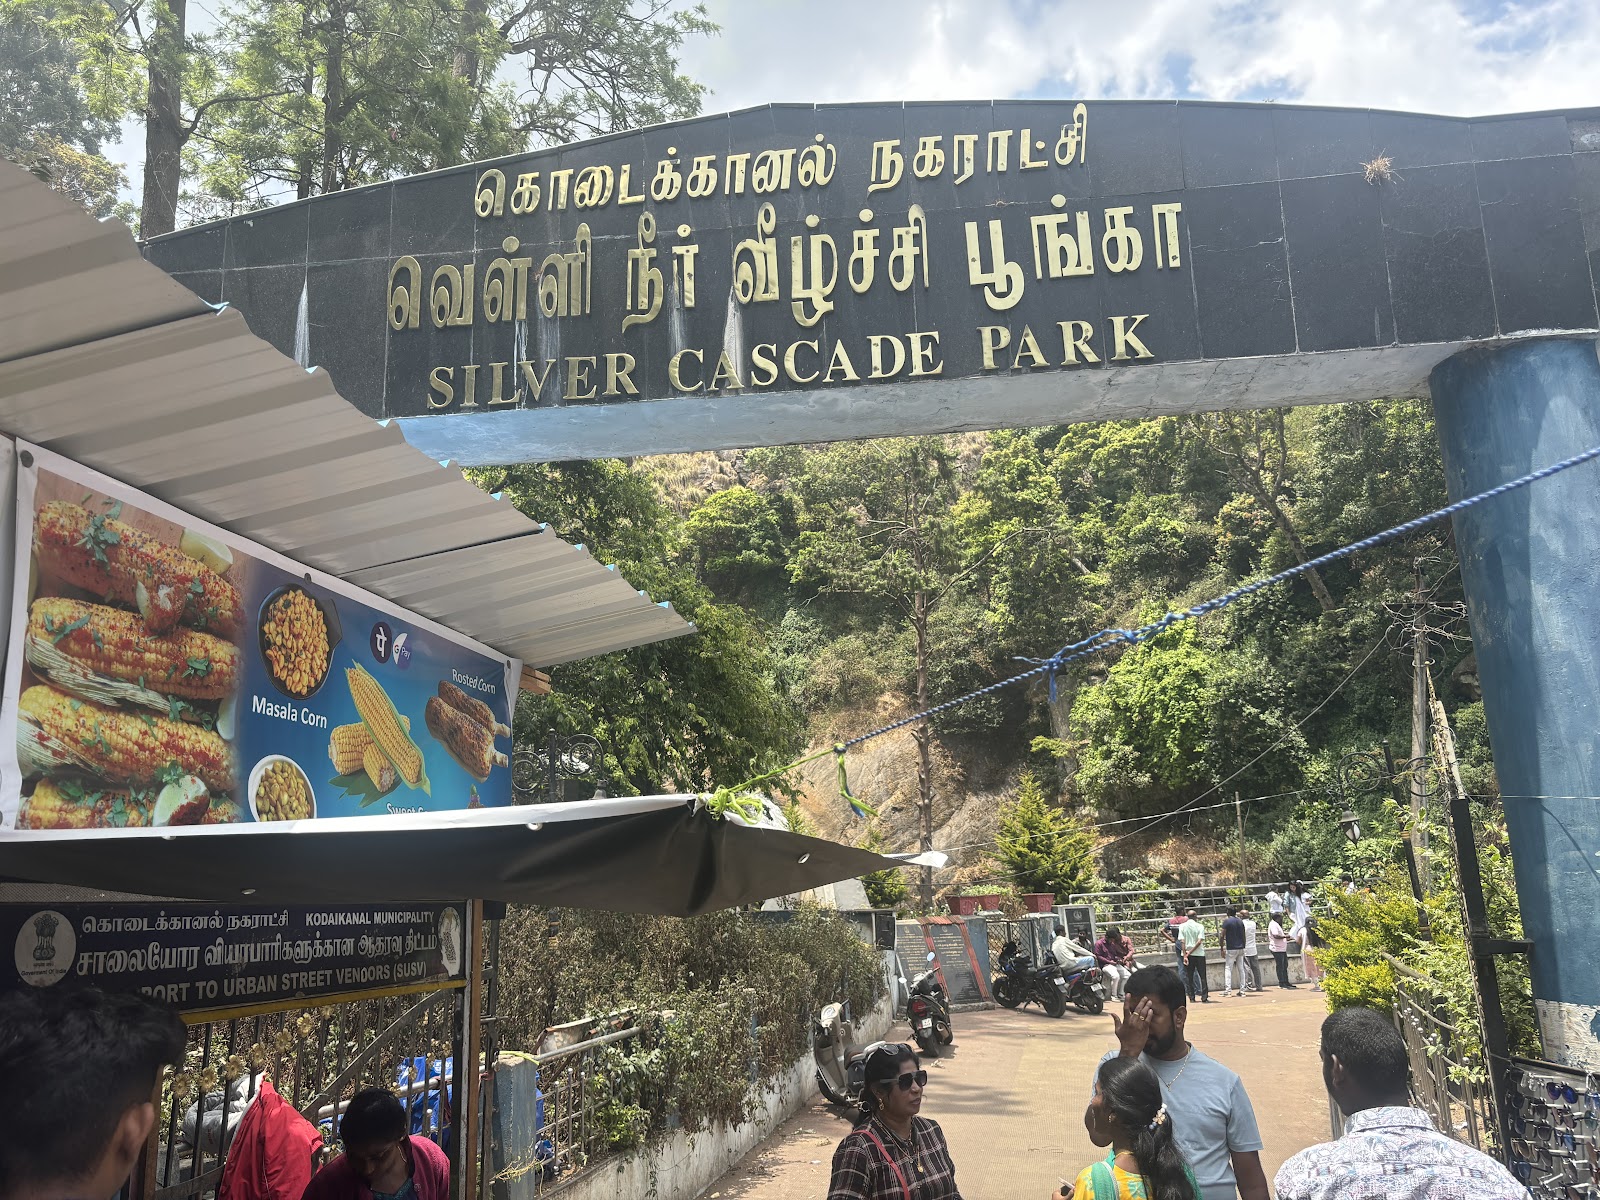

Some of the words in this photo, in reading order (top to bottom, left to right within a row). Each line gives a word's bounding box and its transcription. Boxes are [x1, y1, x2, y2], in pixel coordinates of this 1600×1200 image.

[474, 133, 837, 218] கொடைக்கானல்
[867, 102, 1088, 199] நகராட்சி
[387, 222, 592, 331] வெள்ளி
[621, 210, 699, 334] நீர்
[732, 202, 929, 328] வீழ்ச்சி
[964, 193, 1182, 311] பூங்கா
[426, 352, 640, 410] SILVER
[668, 330, 945, 393] CASCADE
[975, 313, 1155, 370] PARK
[452, 668, 477, 689] Rosted
[477, 679, 496, 695] Corn
[252, 695, 298, 723] Masala
[300, 707, 328, 729] Corn
[82, 910, 224, 933] கொடைக்கானல்
[226, 909, 289, 933] நகராட்சி
[305, 911, 371, 926] KODAIKANAL
[373, 911, 435, 925] MUNICIPALITY
[76, 941, 201, 976] சாலையோர
[357, 934, 403, 959] ஆதரவு
[404, 927, 438, 956] திட்டம்
[195, 980, 218, 1000] TO
[223, 974, 277, 997] URBAN
[281, 969, 333, 991] STREET
[336, 964, 391, 985] VENDORS
[393, 961, 427, 982] (SUSV)
